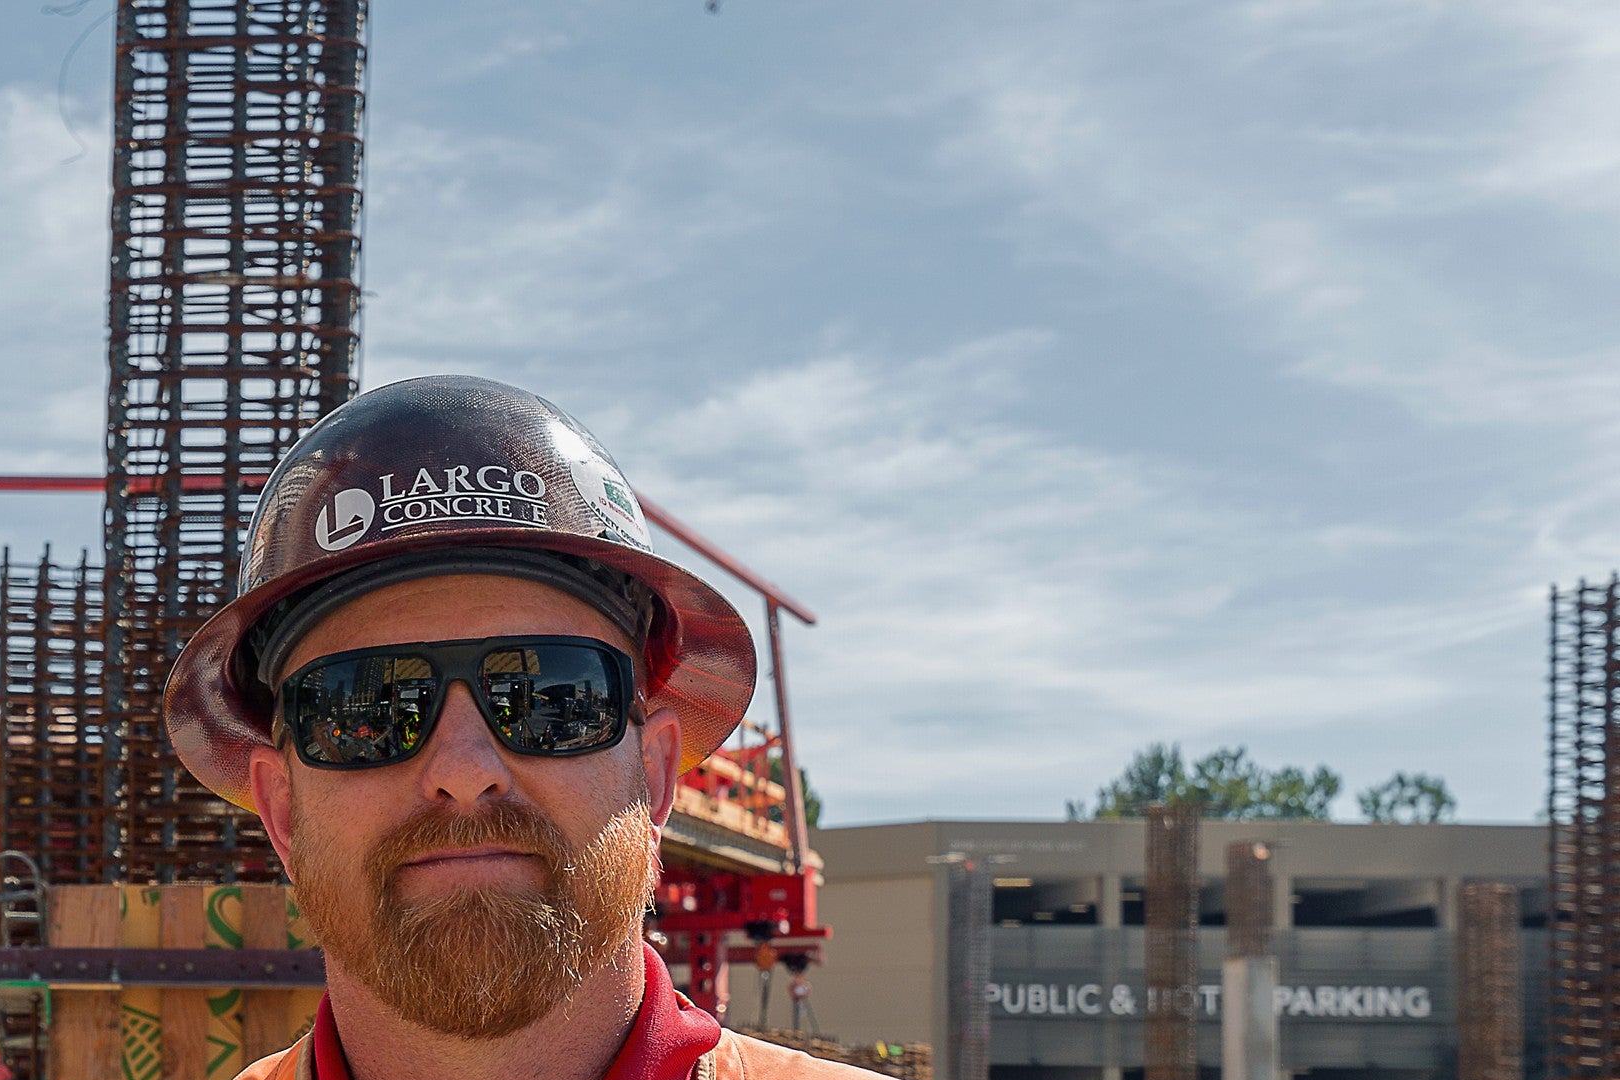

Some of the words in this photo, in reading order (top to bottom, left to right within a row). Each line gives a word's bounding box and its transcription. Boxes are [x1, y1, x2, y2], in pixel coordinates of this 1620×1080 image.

[379, 465, 546, 502] LARGO
[383, 497, 548, 526] CONCREE
[983, 983, 1102, 1015] PUBLIC
[1109, 983, 1137, 1016] &
[1272, 984, 1432, 1018] PARKING
